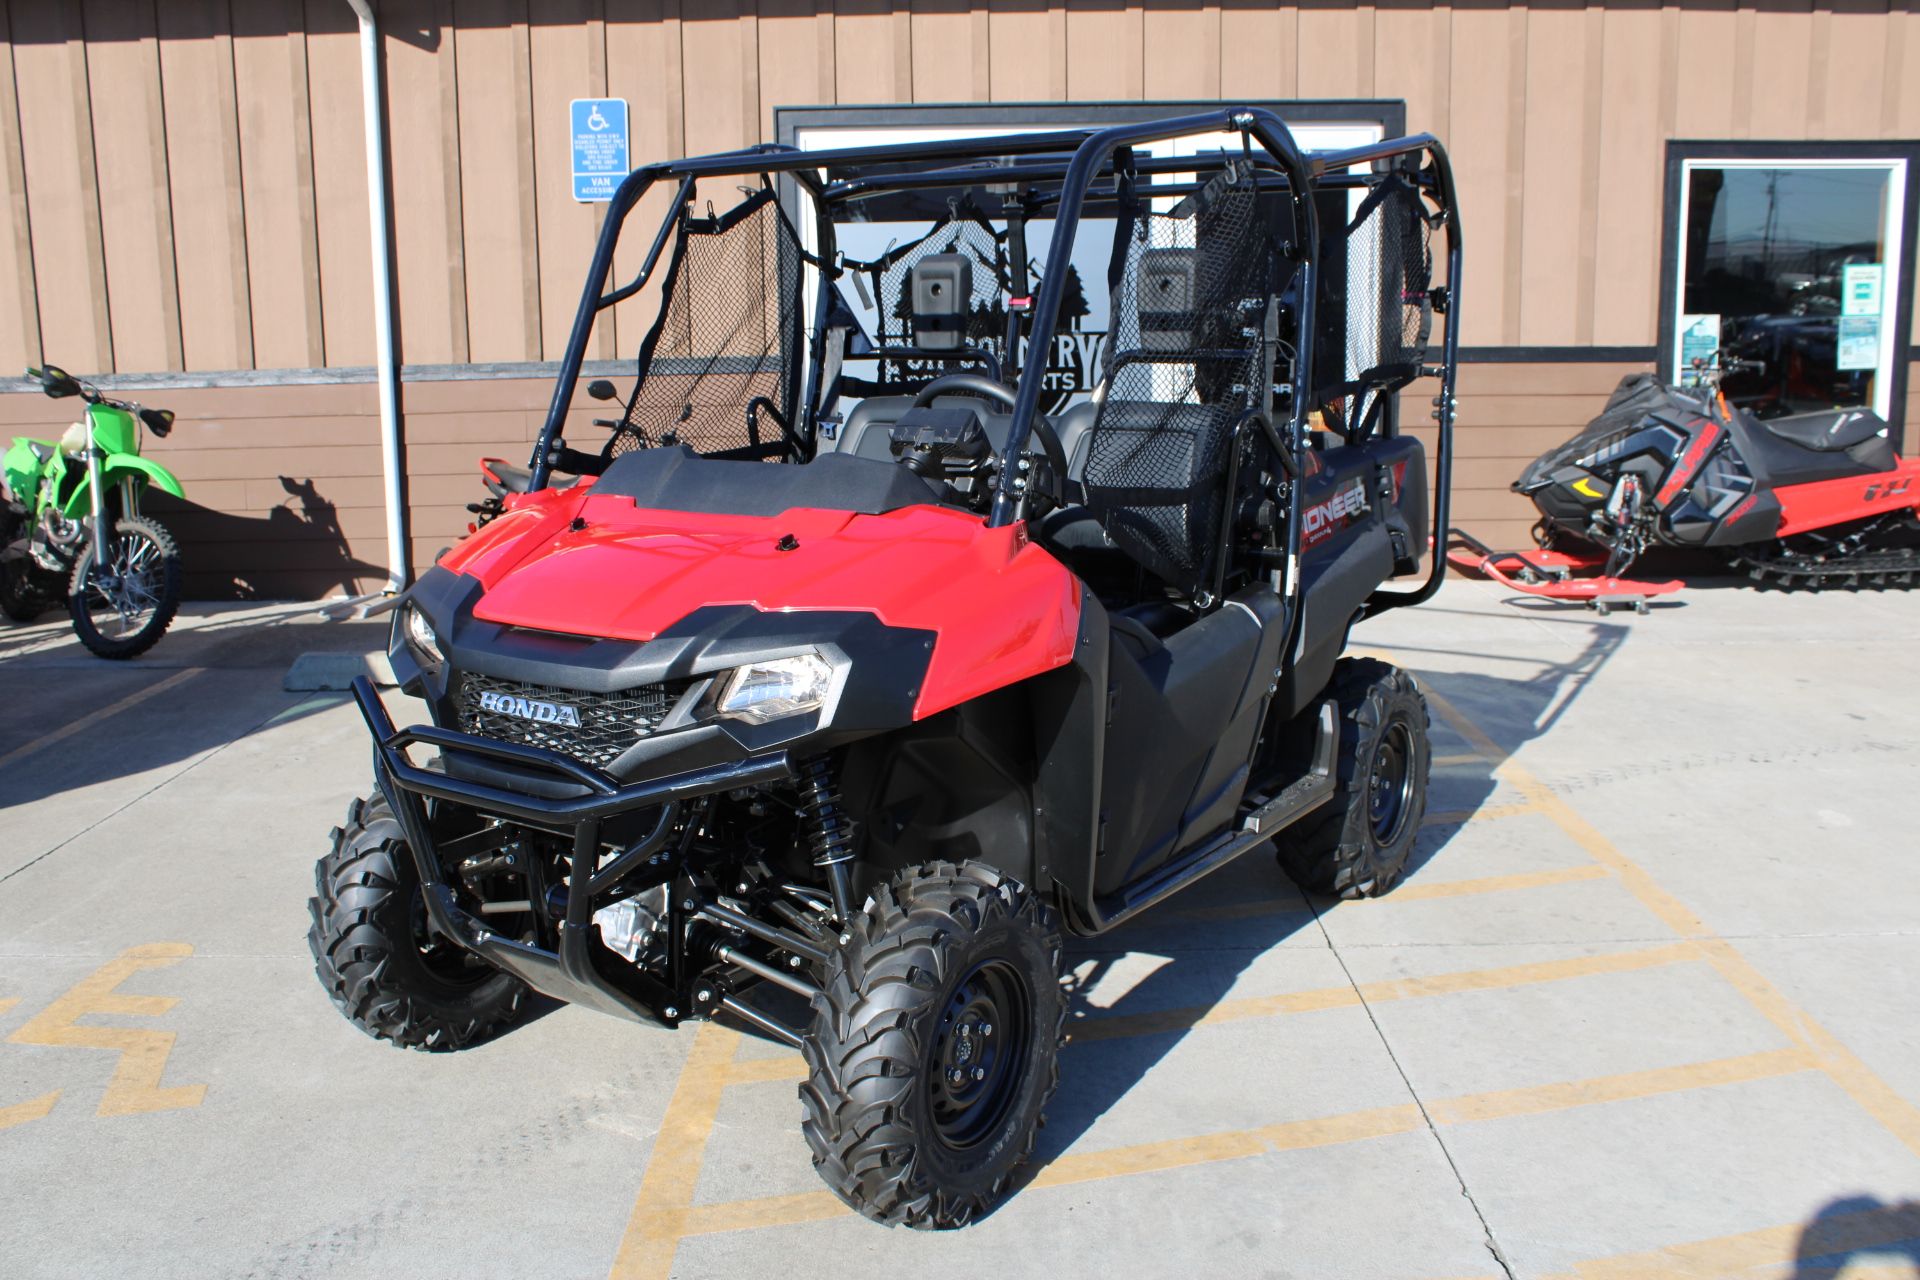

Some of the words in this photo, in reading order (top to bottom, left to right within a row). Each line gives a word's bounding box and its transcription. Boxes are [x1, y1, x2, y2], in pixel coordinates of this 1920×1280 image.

[591, 177, 610, 186] VAN
[1302, 484, 1366, 534] IONEER
[480, 691, 581, 728] HONDA
